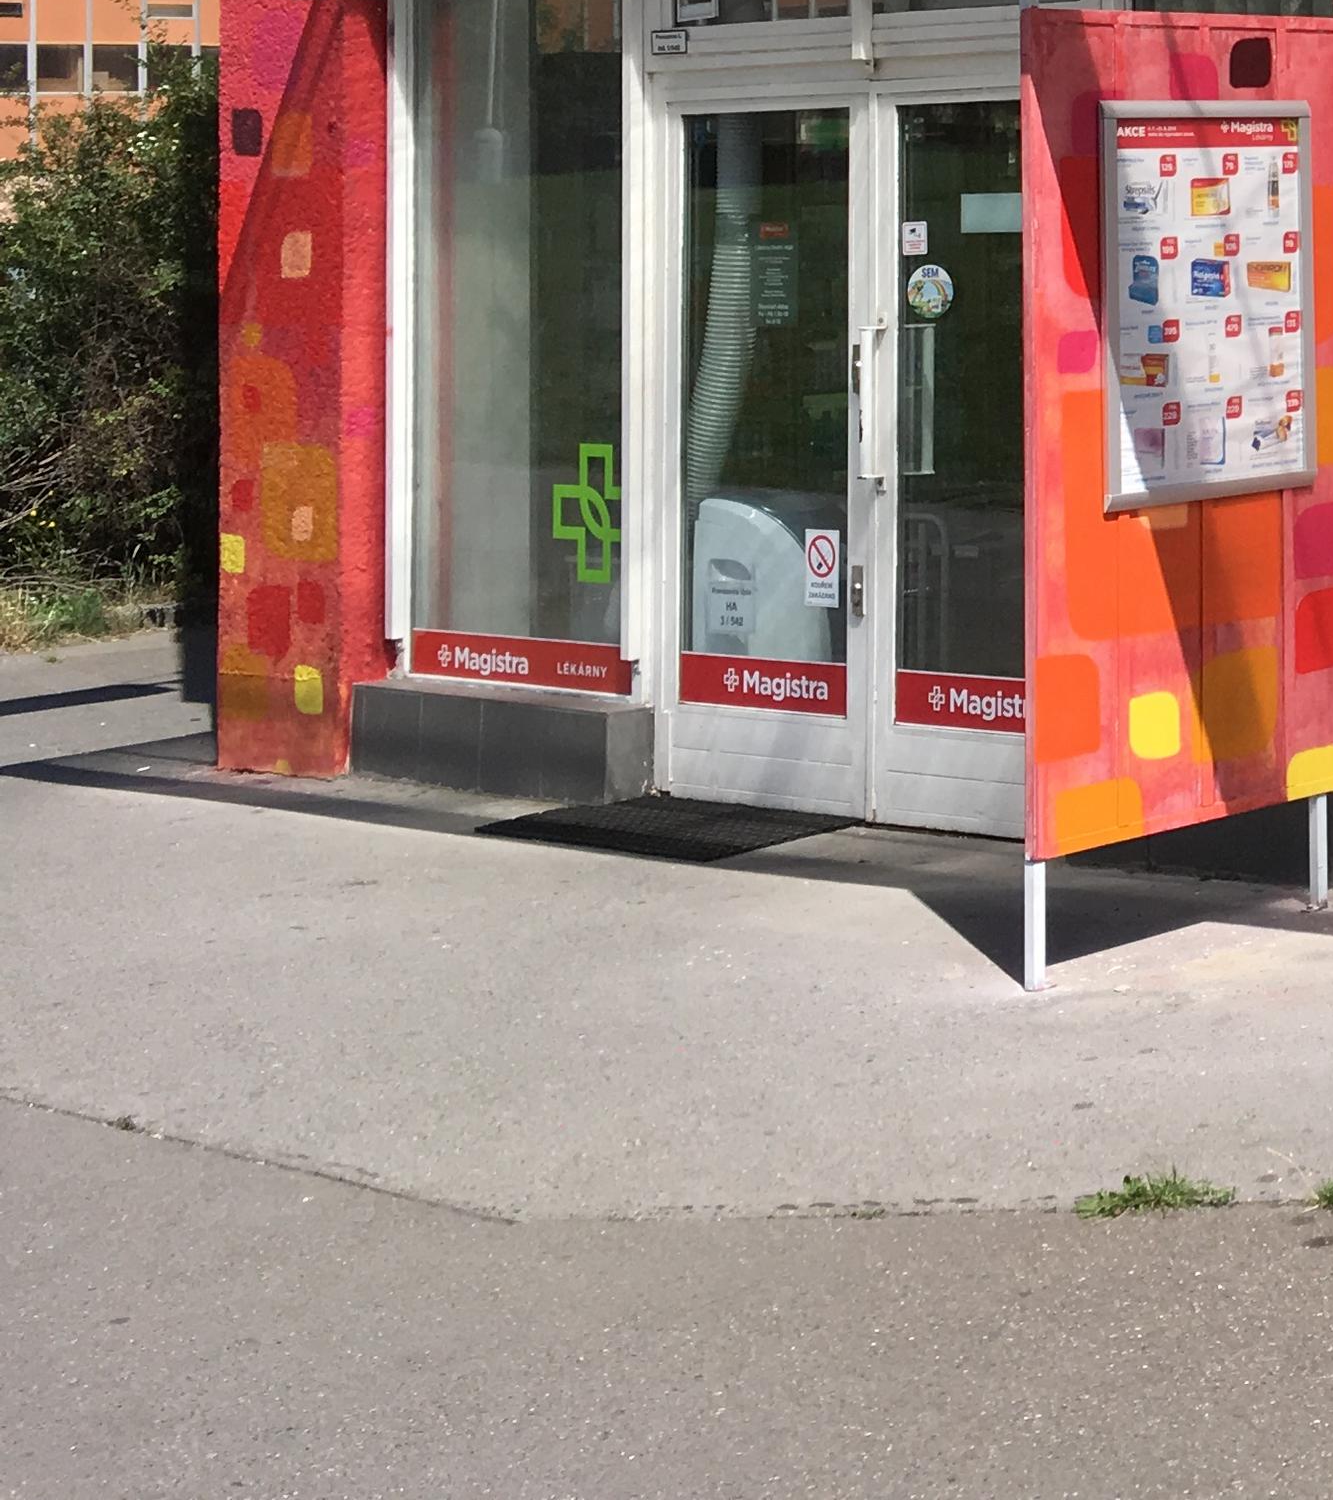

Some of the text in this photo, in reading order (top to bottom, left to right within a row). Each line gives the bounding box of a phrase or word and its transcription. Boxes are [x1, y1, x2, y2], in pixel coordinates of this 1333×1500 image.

[1117, 126, 1145, 137] AKCE
[1231, 121, 1274, 134] Magistra
[921, 267, 940, 278] SEM
[454, 646, 608, 679] Magistra LÉKÁRNY
[742, 670, 829, 702] Magistra
